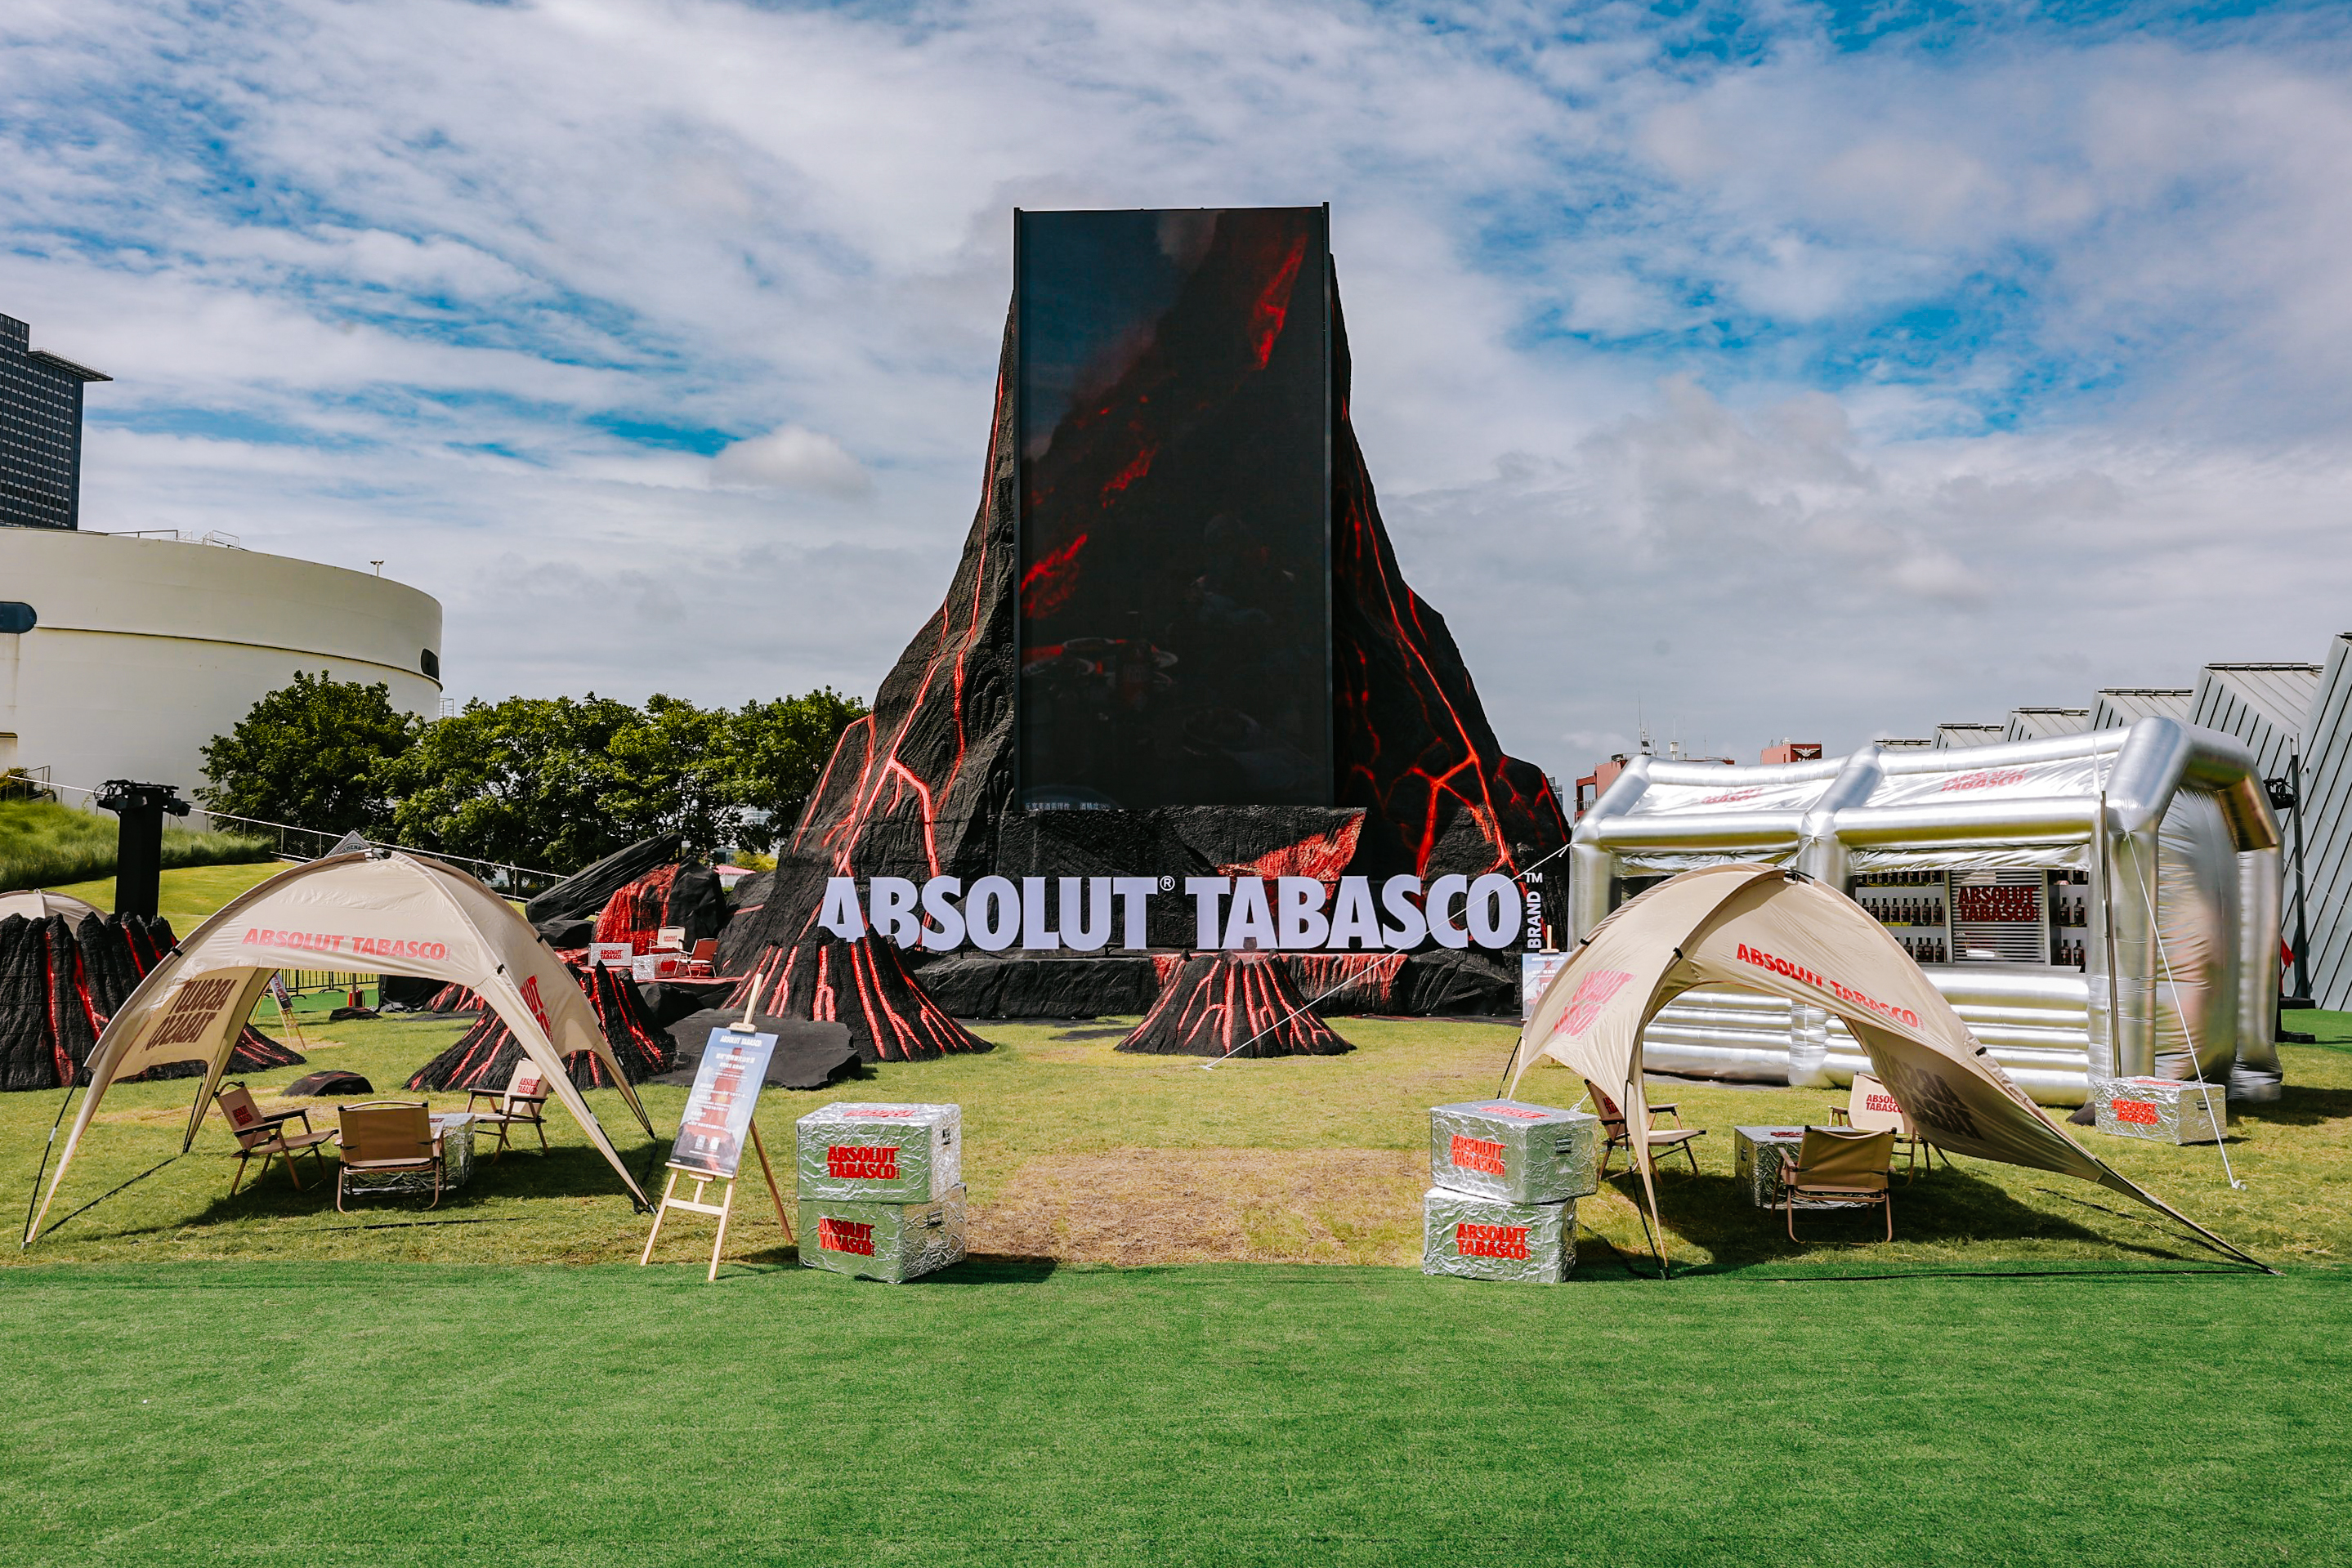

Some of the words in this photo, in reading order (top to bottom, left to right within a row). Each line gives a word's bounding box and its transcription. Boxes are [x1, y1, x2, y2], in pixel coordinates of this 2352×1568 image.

[1957, 886, 2038, 904] ABSOLUT
[1185, 873, 1523, 950] TABASCO
[1527, 891, 1542, 949] BRAND
[1957, 904, 2034, 922] TABASCO
[242, 928, 345, 952] ABSOLUT
[351, 936, 446, 961] TABASCO
[1737, 943, 1823, 988] ABSOLUT
[1830, 980, 1919, 1028] TABASCO
[1866, 1093, 1898, 1104] ABSOL
[827, 1145, 901, 1163] ABSOLUT
[1451, 1134, 1506, 1159] ABSOLUT
[827, 1163, 896, 1180] TABASCO
[1451, 1150, 1502, 1177] TABASCO
[818, 1217, 875, 1240] ABSOLUT
[1455, 1223, 1532, 1244] ABSOLUT
[819, 1233, 872, 1257] TABASCO
[1455, 1239, 1527, 1261] TABASCO
